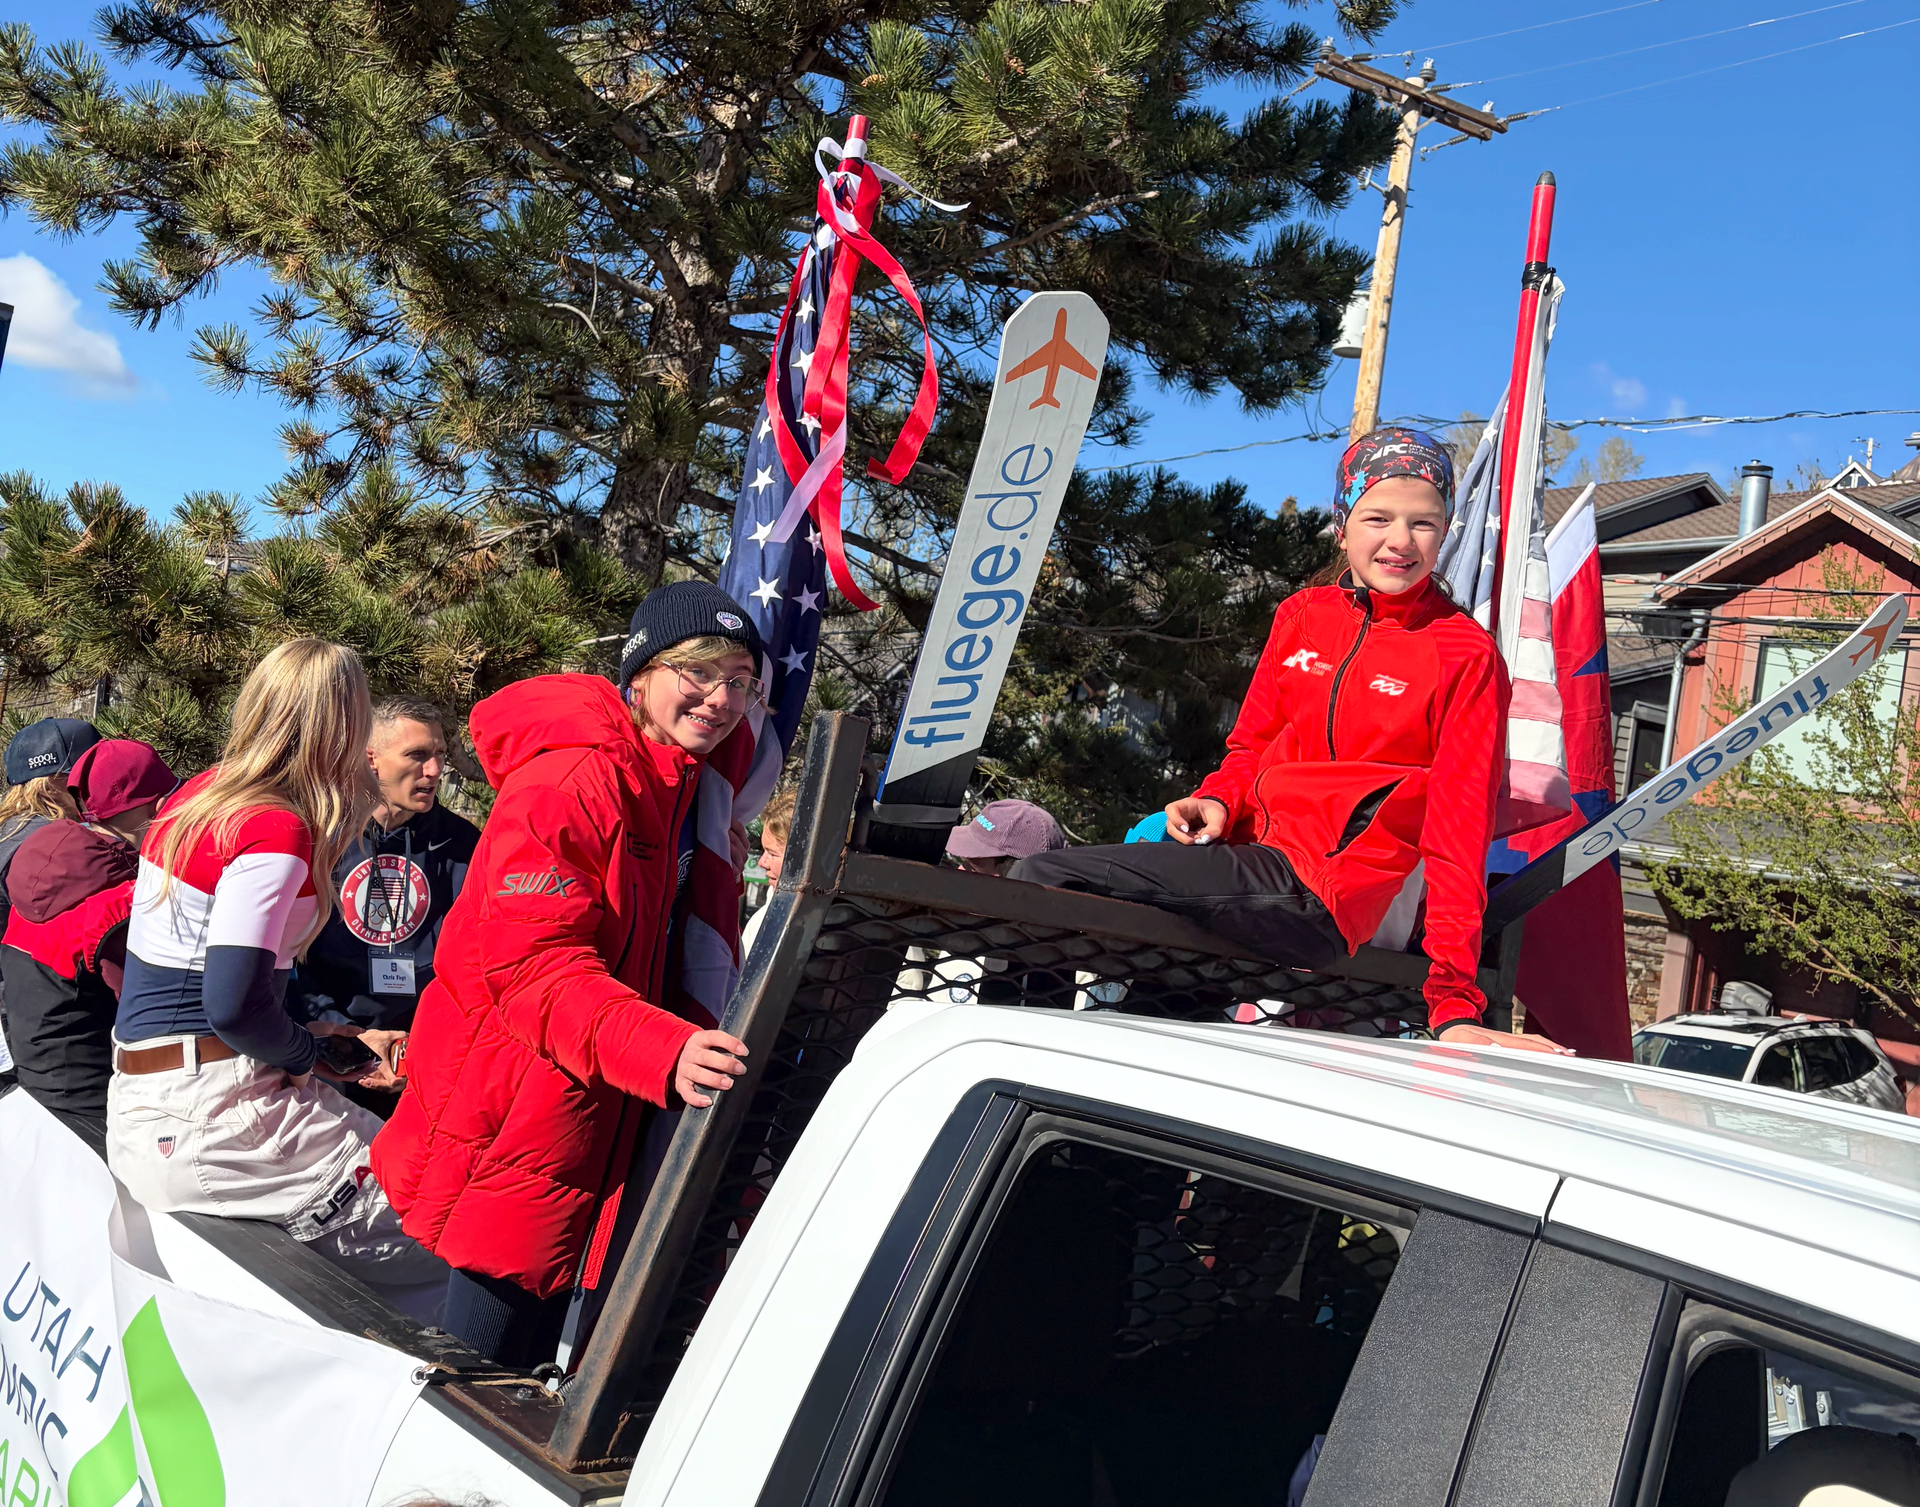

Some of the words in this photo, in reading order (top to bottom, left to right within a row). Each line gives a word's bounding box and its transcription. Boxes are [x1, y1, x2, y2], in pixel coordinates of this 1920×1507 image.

[904, 443, 1054, 748] fluege.de
[1583, 675, 1831, 856] fluege.de
[355, 858, 387, 880] UNID
[311, 1165, 372, 1227] USA
[3, 1261, 112, 1404] UTAH
